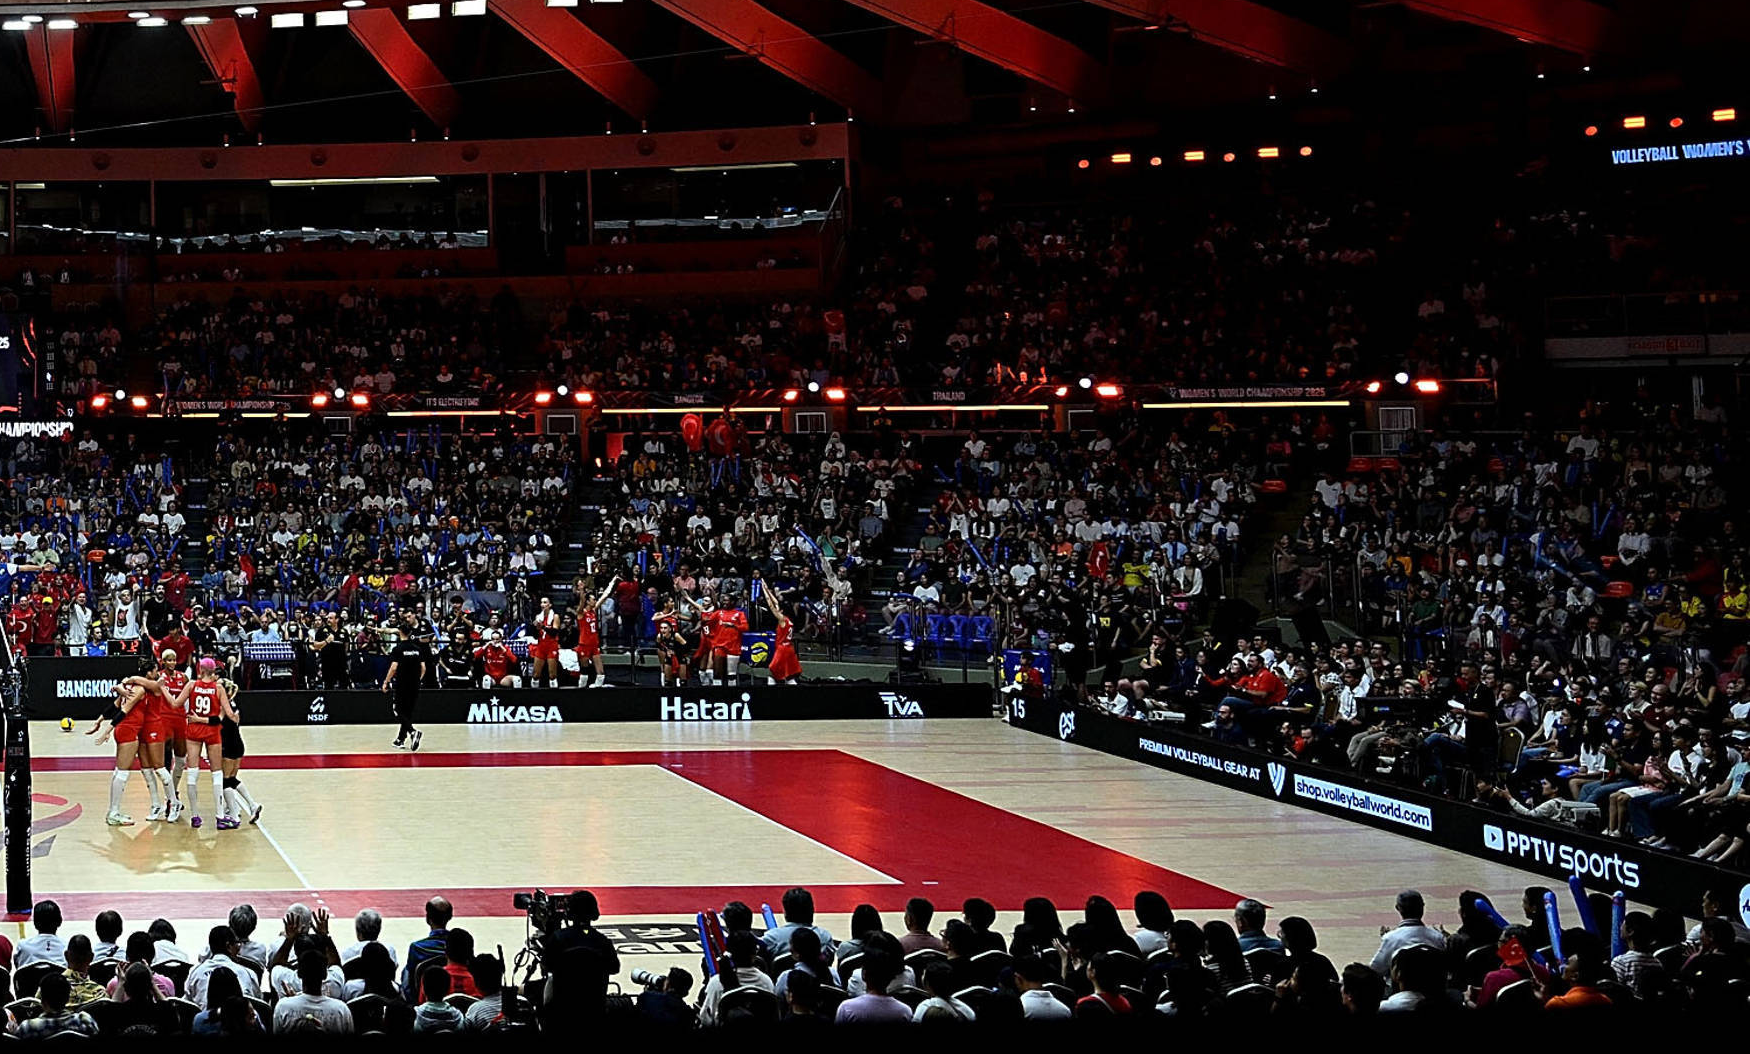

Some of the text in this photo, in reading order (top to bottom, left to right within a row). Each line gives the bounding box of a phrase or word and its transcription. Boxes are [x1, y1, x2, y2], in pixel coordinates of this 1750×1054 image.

[1612, 146, 1680, 165] VOLLEYBALL
[1682, 140, 1744, 159] WOMEN'S
[56, 679, 119, 698] BANGKOK
[195, 695, 211, 715] 99
[660, 692, 752, 720] Hatari
[1010, 697, 1026, 719] 15
[1139, 737, 1262, 781] PREMIUM VOLLEYBALL GEAR AT
[1296, 779, 1430, 827] shop.volleyballworld.com
[1506, 830, 1640, 888] PPTV sports
